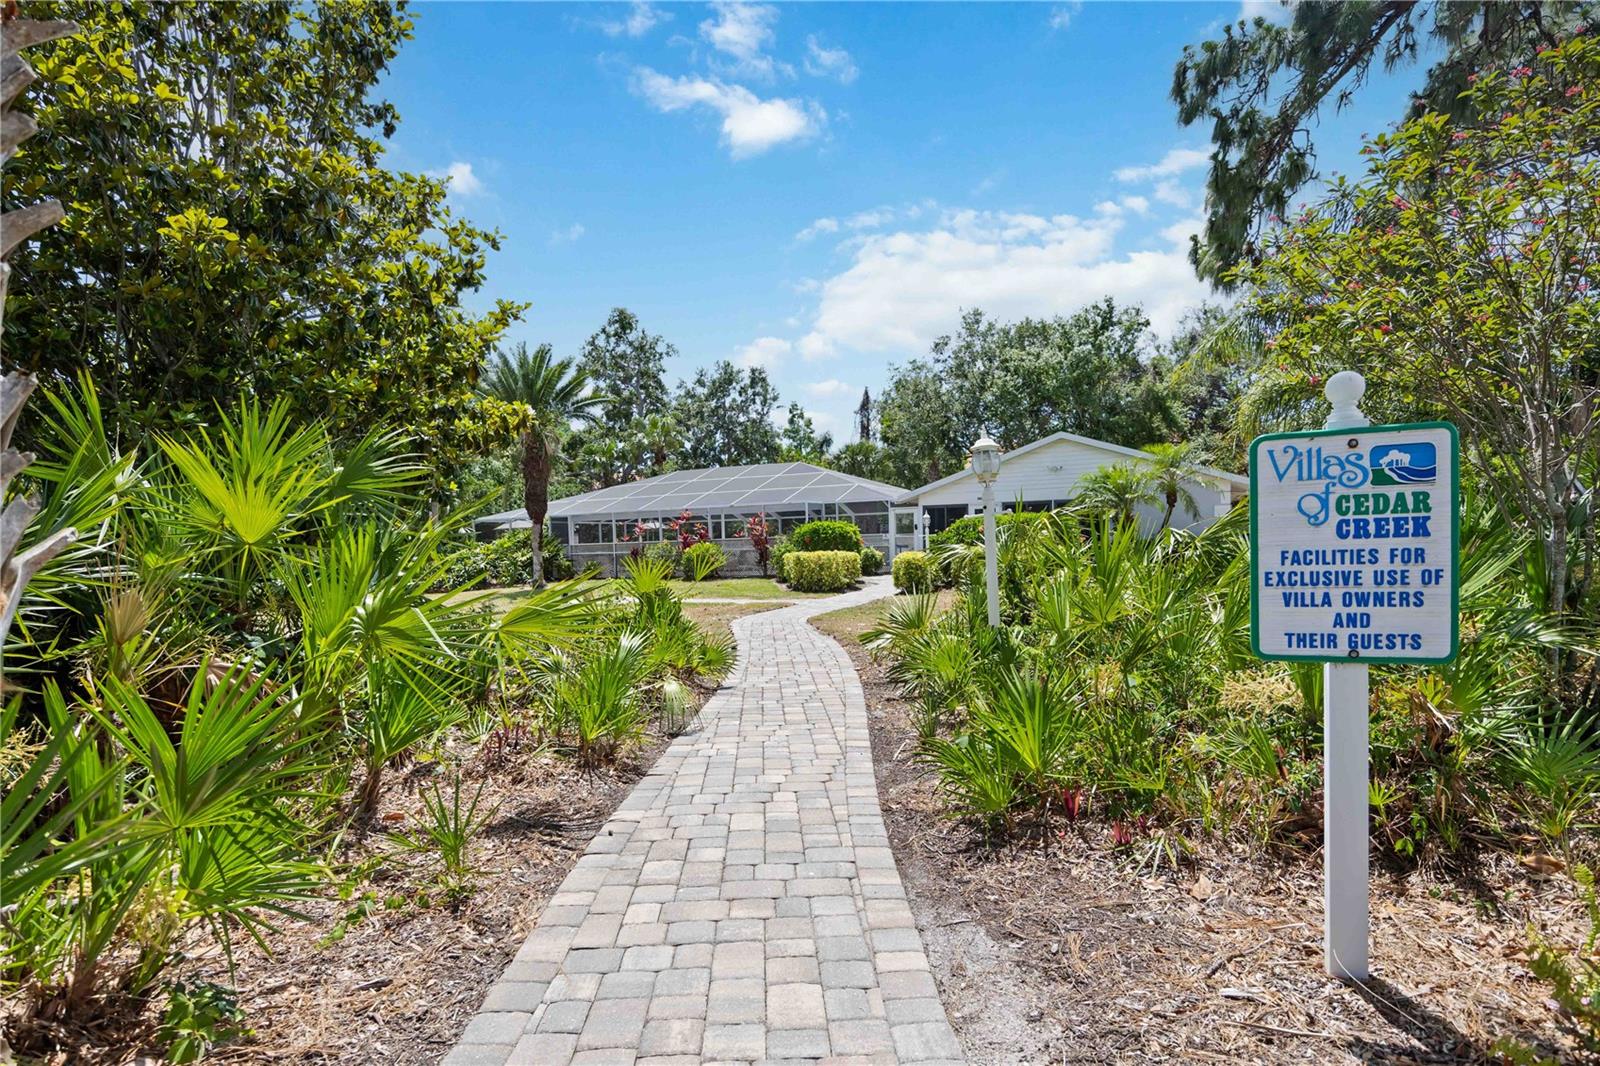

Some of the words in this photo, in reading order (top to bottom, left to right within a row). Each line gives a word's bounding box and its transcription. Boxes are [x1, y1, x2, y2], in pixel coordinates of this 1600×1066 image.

[1267, 445, 1370, 489] Villas
[1335, 491, 1432, 516] CEDAR
[1336, 516, 1431, 539] CREEK
[1281, 549, 1379, 566] FACILITIES
[1390, 548, 1426, 564] FOR
[1264, 570, 1363, 587] EXCLUSIVE
[1373, 569, 1410, 586] USE
[1421, 569, 1444, 586] OF
[1282, 592, 1332, 607] VILLA
[1342, 591, 1424, 607] OWNERS
[1333, 613, 1370, 629] AND
[1284, 633, 1338, 649] THEIR
[1347, 633, 1422, 650] GUESTS
